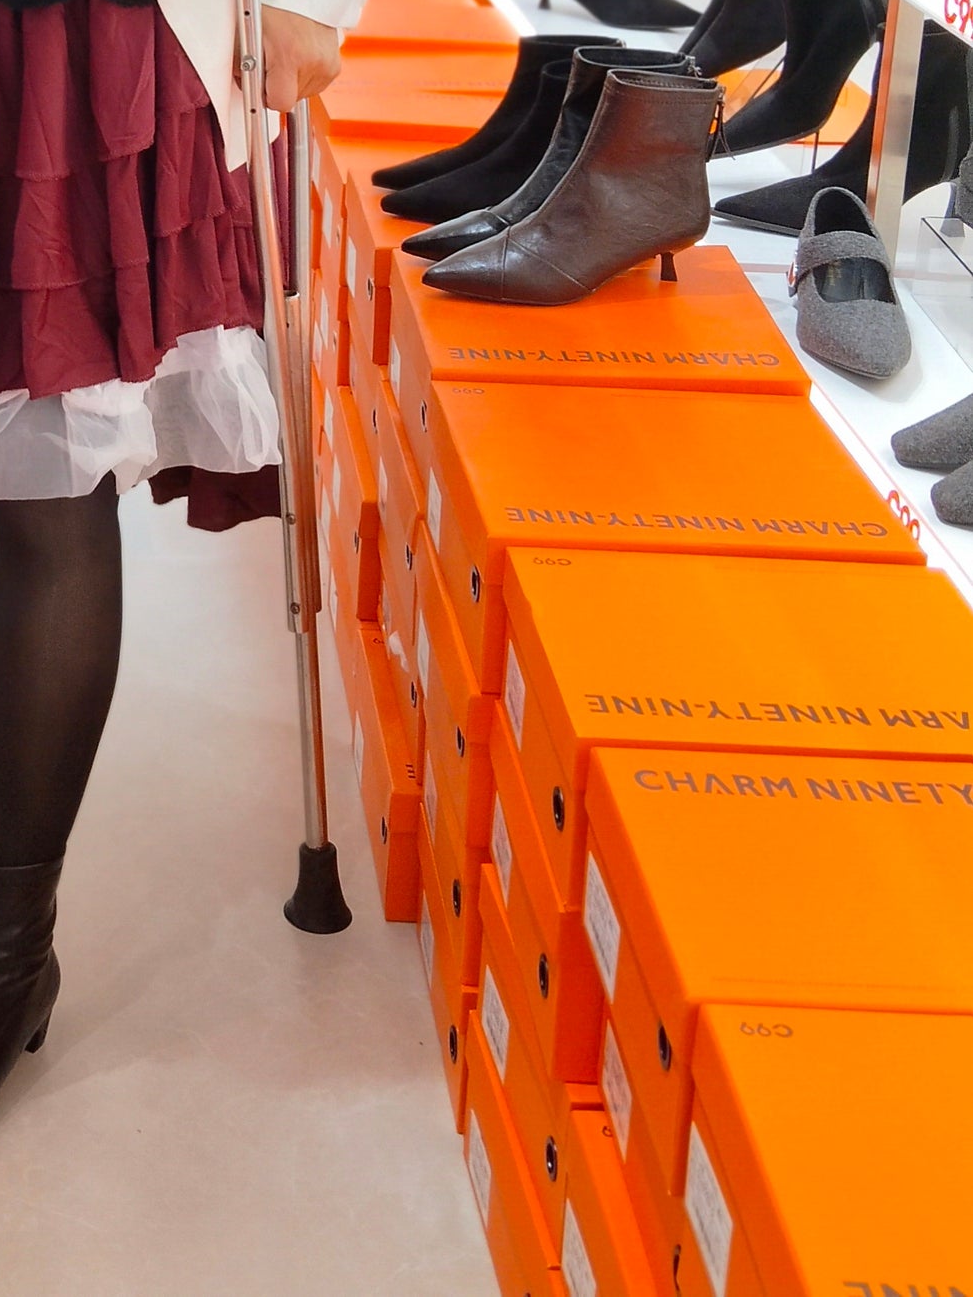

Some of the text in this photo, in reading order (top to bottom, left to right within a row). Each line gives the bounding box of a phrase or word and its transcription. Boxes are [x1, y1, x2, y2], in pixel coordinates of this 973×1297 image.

[663, 351, 780, 366] CHARM
[752, 518, 888, 537] CHARM
[634, 769, 797, 799] CHARM
